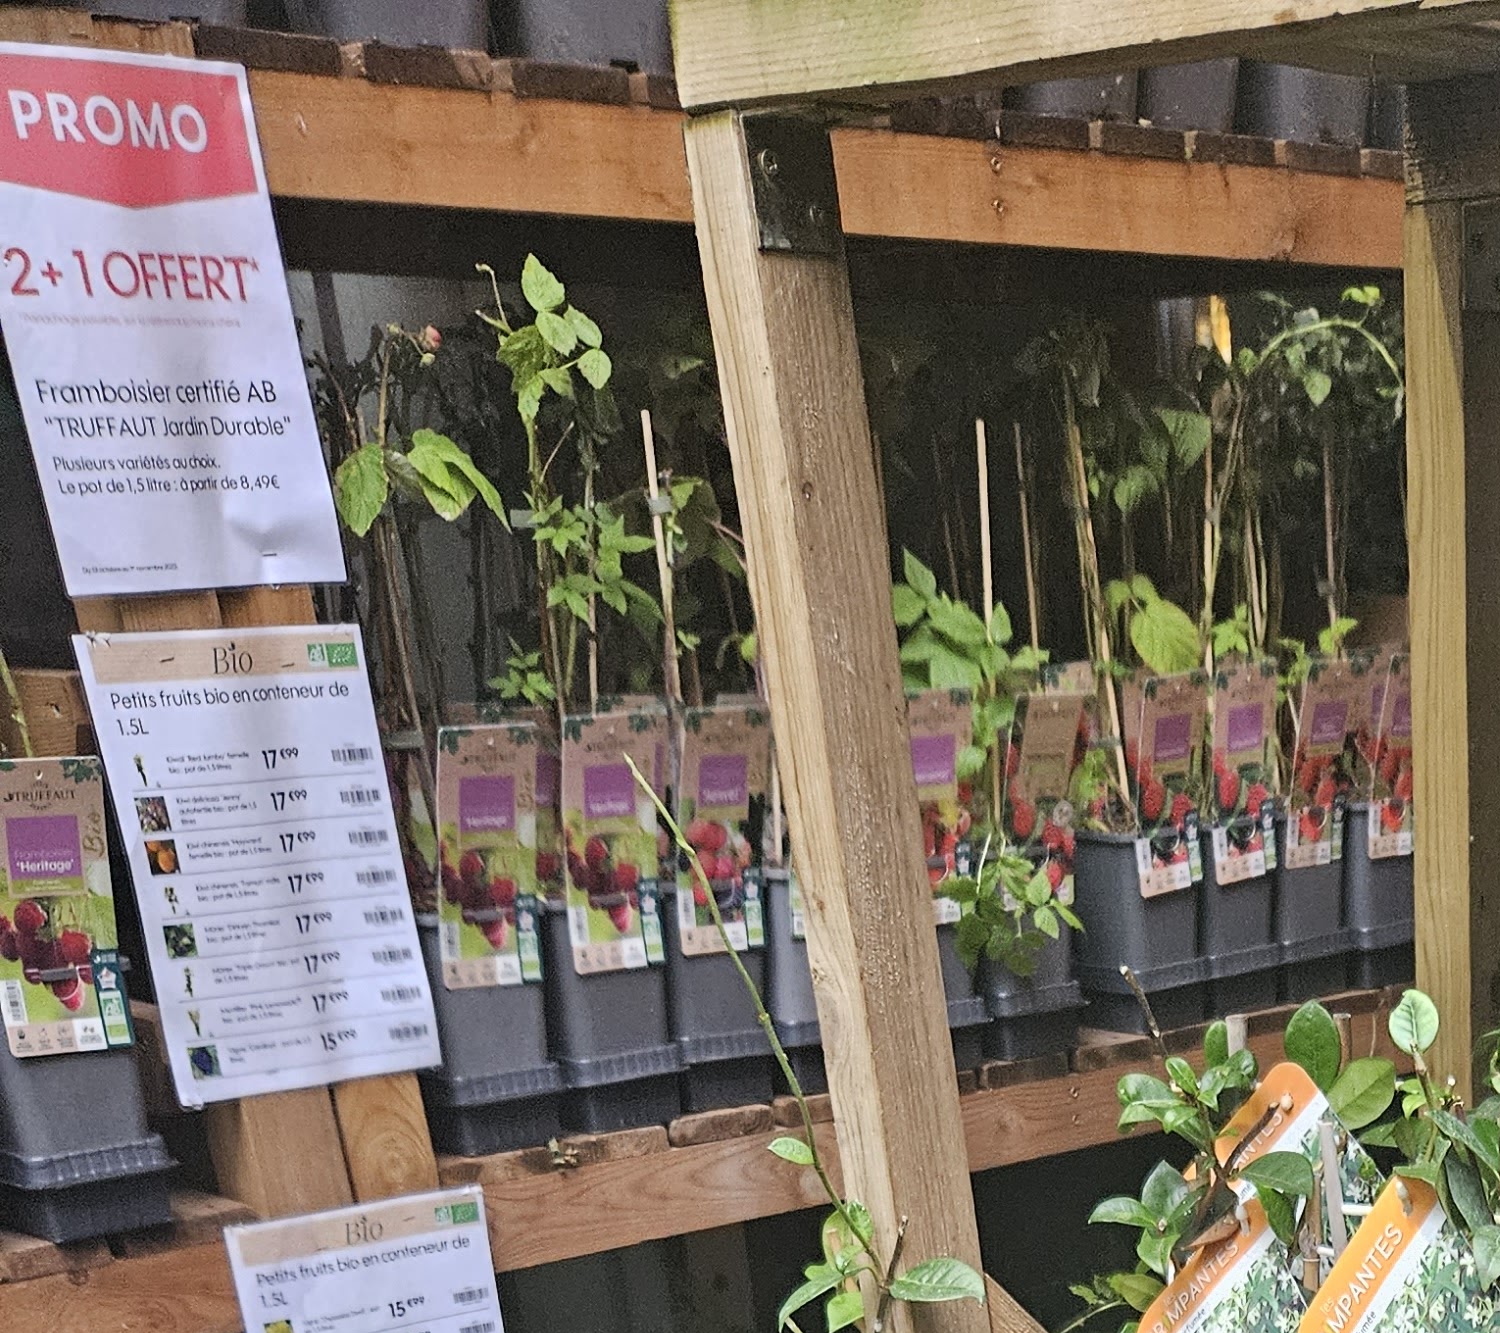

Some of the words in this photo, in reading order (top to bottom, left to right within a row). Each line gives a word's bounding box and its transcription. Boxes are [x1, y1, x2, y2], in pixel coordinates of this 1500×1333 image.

[7, 88, 208, 153] PROMO
[34, 378, 171, 404] Framboisier
[176, 378, 240, 403] certifié
[247, 380, 277, 403] AB
[163, 416, 208, 438] Jardin
[53, 456, 115, 472] Plusieurs
[117, 455, 170, 471] variétés
[172, 458, 189, 470] au
[57, 479, 75, 494] Le
[78, 479, 102, 496] pot
[106, 478, 124, 492] de
[148, 477, 171, 491] litre
[190, 475, 217, 491] partir
[222, 475, 238, 489] de
[212, 641, 254, 676] Bio
[110, 690, 157, 711] Petits
[159, 688, 202, 708] fruits
[205, 686, 230, 705] bio
[232, 688, 250, 703] en
[252, 683, 325, 702] conteneur
[329, 681, 350, 698] de
[345, 1215, 384, 1245] Bio
[256, 1270, 297, 1288] Petits
[299, 1263, 335, 1280] fruits
[337, 1257, 360, 1271] bio
[361, 1255, 380, 1266] en
[382, 1241, 449, 1264] conteneur
[452, 1235, 470, 1249] de
